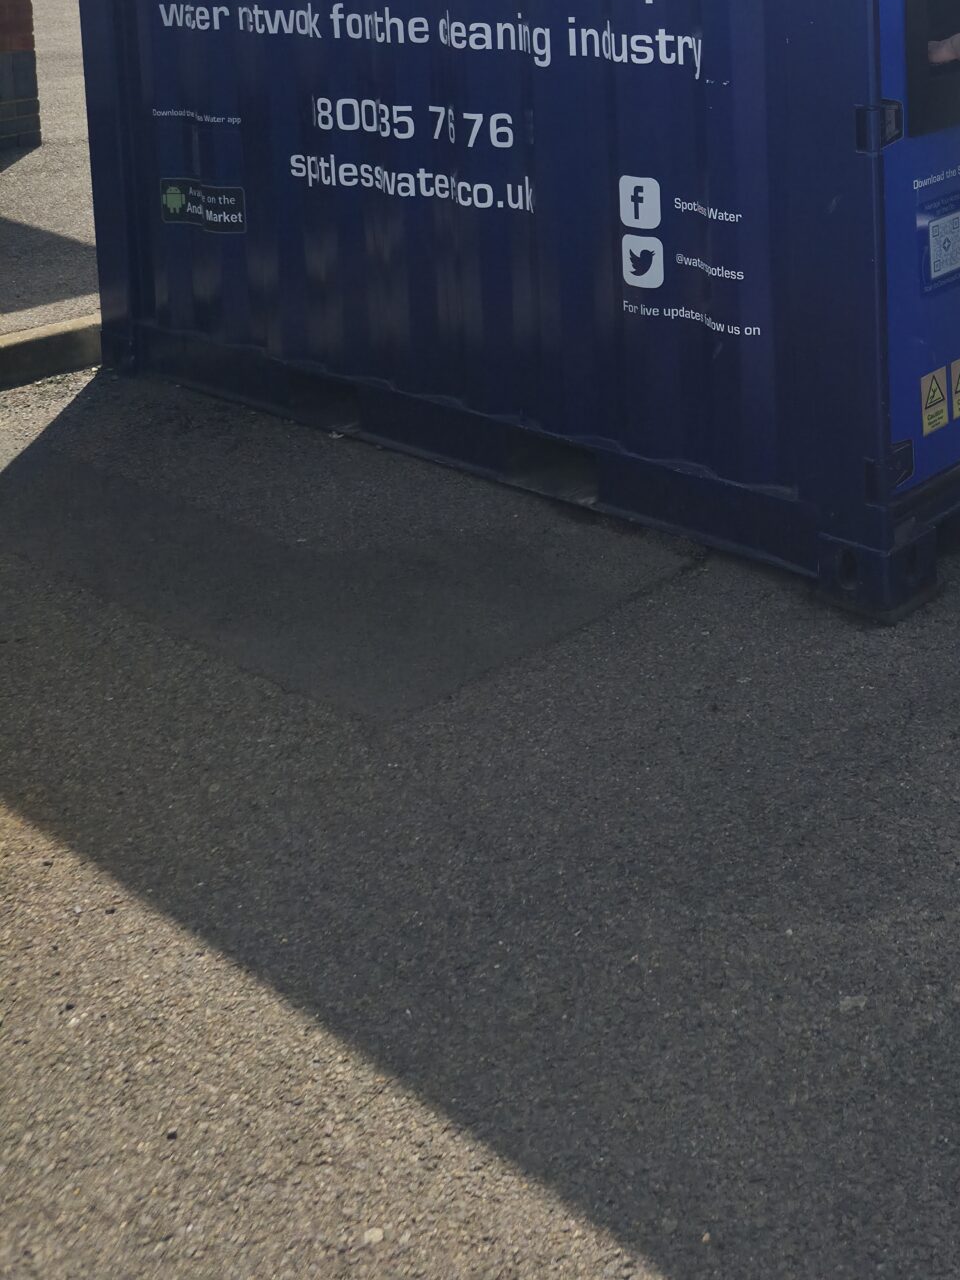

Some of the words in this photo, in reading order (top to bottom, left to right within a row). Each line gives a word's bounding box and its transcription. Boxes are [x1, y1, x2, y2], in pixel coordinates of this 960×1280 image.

[238, 2, 322, 39] ntwok
[374, 6, 430, 44] the
[568, 16, 702, 79] industry
[227, 117, 242, 125] app
[311, 94, 378, 132] 800
[378, 103, 415, 139] 35
[428, 105, 456, 144] 76
[462, 112, 514, 148] 76
[290, 153, 534, 214] sptlesswater.co.uk
[913, 171, 945, 190] Download
[945, 168, 957, 179] the
[207, 196, 216, 204] on
[218, 195, 236, 205] the
[205, 209, 243, 223] Market
[623, 300, 639, 314] For
[640, 304, 660, 316] live
[663, 306, 704, 322] updates
[727, 324, 741, 335] us
[744, 326, 761, 336] on
